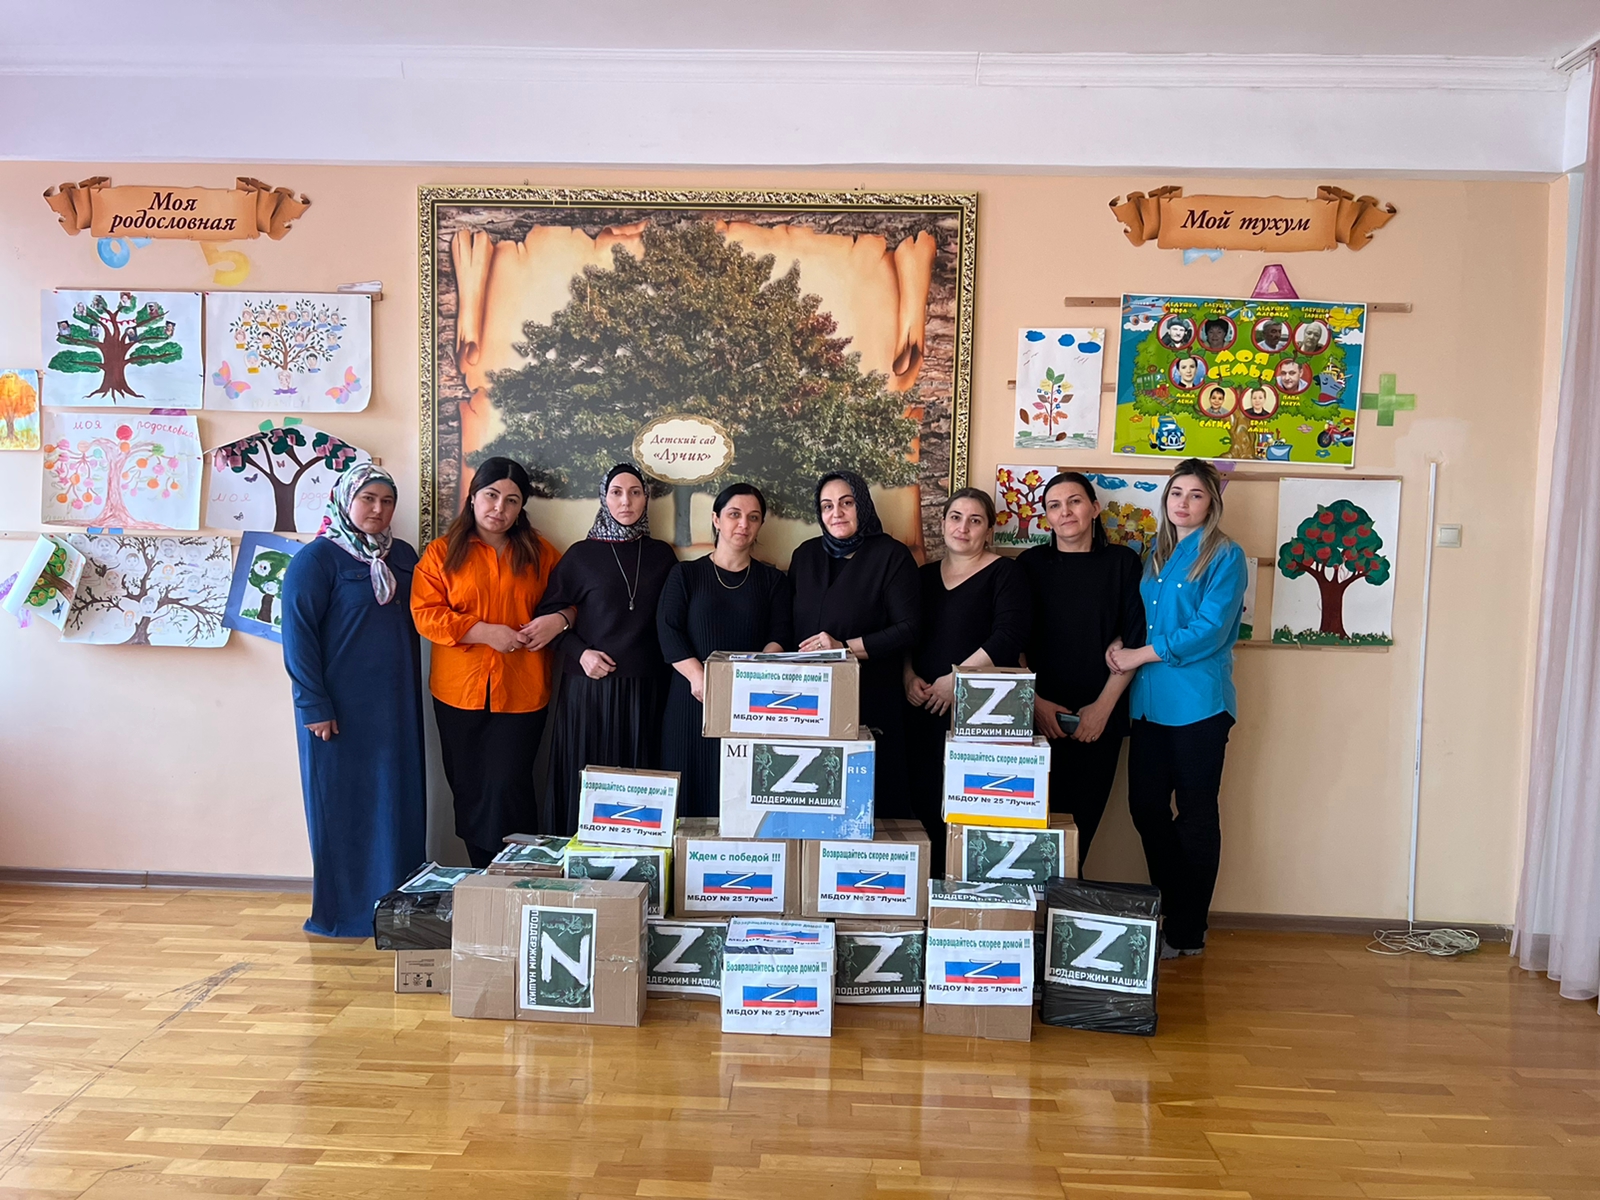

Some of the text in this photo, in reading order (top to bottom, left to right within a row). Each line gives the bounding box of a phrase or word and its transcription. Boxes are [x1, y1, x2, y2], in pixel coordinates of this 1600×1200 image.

[148, 192, 198, 211] Моя
[108, 210, 237, 233] родословная
[1181, 209, 1311, 236] Мой тухум
[1215, 350, 1269, 365] МОЯ
[1208, 363, 1275, 382] СЕМЬЯ
[650, 434, 717, 445] Детский сад
[653, 448, 711, 464] «Лучик»
[735, 668, 780, 682] Возвращайтесь
[782, 672, 802, 683] скорее
[803, 672, 822, 683] домой
[790, 716, 824, 724] "Лучик"
[950, 750, 995, 763] Возвращайтесь
[996, 754, 1018, 765] скорее
[1018, 755, 1038, 765] домой
[627, 785, 648, 795] скорее
[648, 786, 667, 796] домой
[750, 795, 842, 806] ПОДДЕРЖИМ НАШИХ!
[948, 794, 979, 802] МБДОУ
[1006, 798, 1040, 806] "Лучик"
[621, 826, 632, 834] 25
[634, 828, 667, 836] "Лучик"
[688, 851, 718, 862] Ждем
[728, 852, 770, 863] победой
[771, 853, 781, 862] !!!
[822, 848, 868, 860] Возвращайтесь
[868, 852, 890, 862] скорее
[890, 851, 909, 862] домой
[687, 894, 718, 902] МБДОУ
[853, 894, 864, 902] №
[878, 896, 911, 904] "Лучик"
[529, 910, 539, 969] ПОДДЕРЖИМ
[978, 938, 1001, 950] скорее
[1002, 938, 1023, 950] домой
[726, 961, 774, 974] Возвращайтесь
[776, 965, 799, 975] скорее
[799, 962, 820, 974] домой
[1049, 967, 1109, 983] ПОДДЕРЖИМ
[836, 986, 891, 996] ПОДДЕРЖИМ
[928, 984, 962, 992] МБДОУ
[991, 986, 1028, 994] "Лучик"
[726, 1009, 760, 1017] МБДОУ
[788, 1009, 824, 1017] "Лучик"
